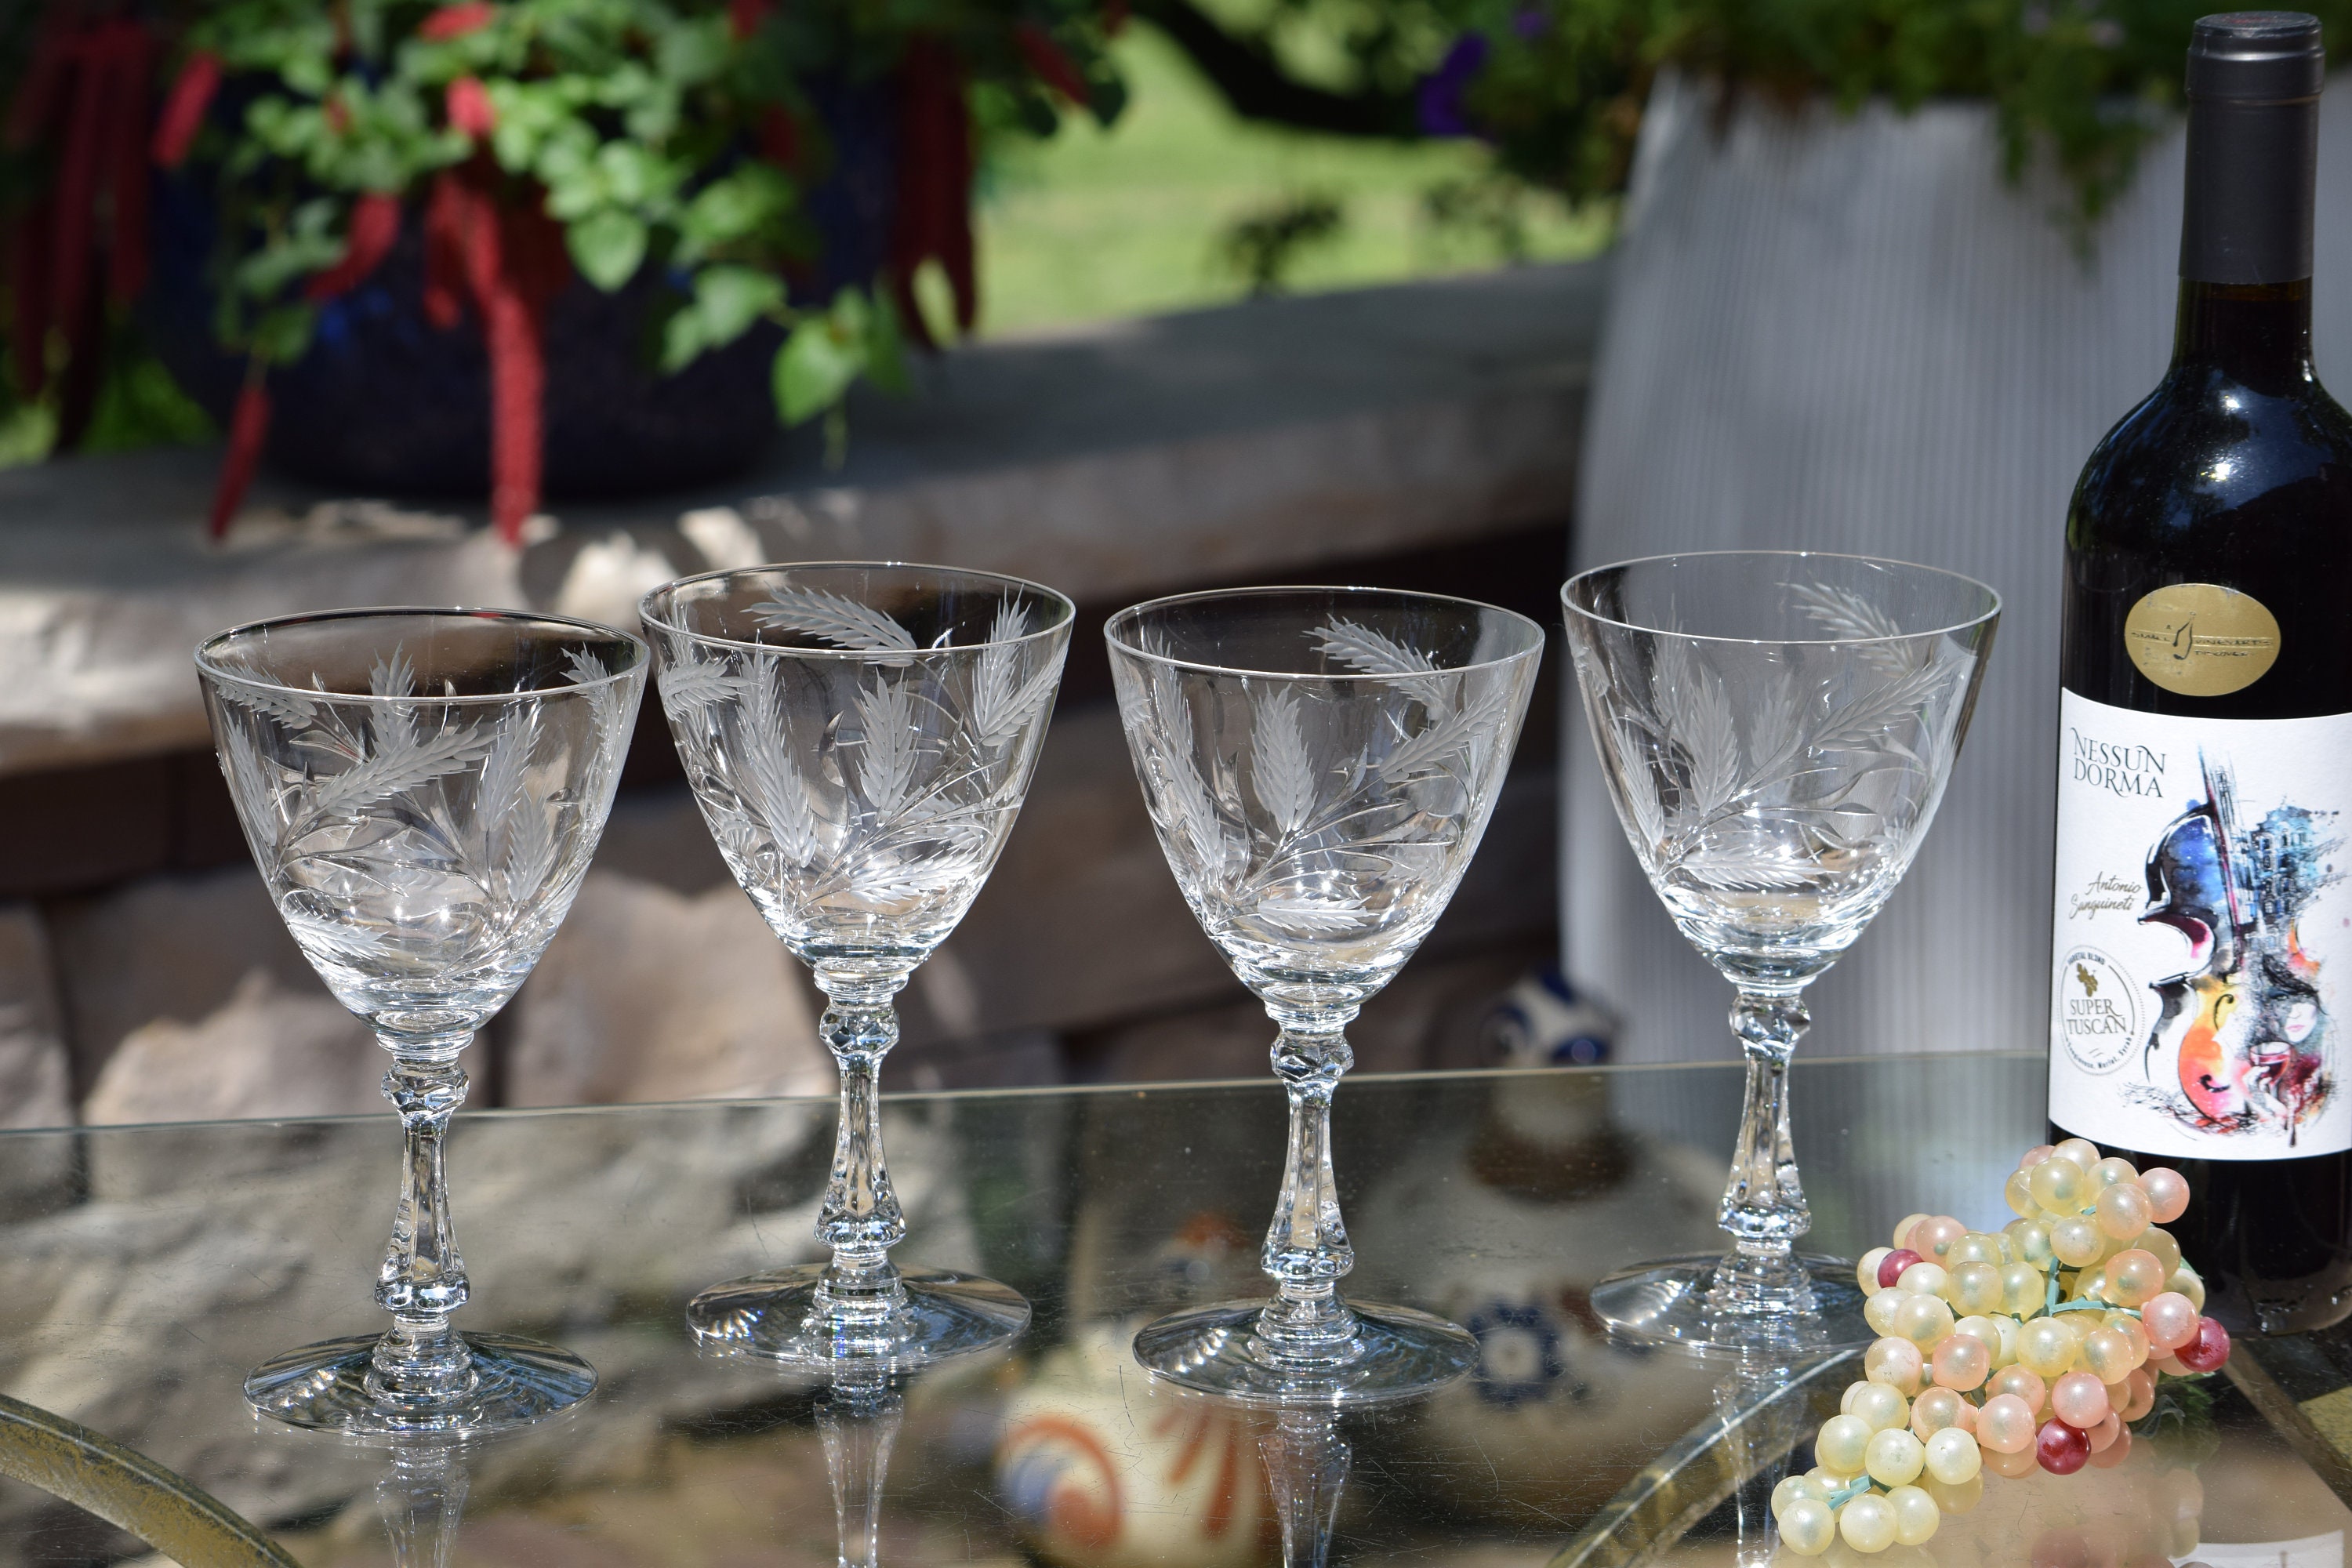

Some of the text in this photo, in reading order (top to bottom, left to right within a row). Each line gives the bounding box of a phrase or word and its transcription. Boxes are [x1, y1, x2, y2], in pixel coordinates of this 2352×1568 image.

[2070, 727, 2166, 775] NESSUN
[2074, 757, 2163, 797] DORMA
[2085, 871, 2142, 895] Antonio
[2069, 893, 2137, 920] Sanguineti
[2070, 998, 2123, 1017] SUPER
[2067, 1014, 2127, 1034] TUSCAN
